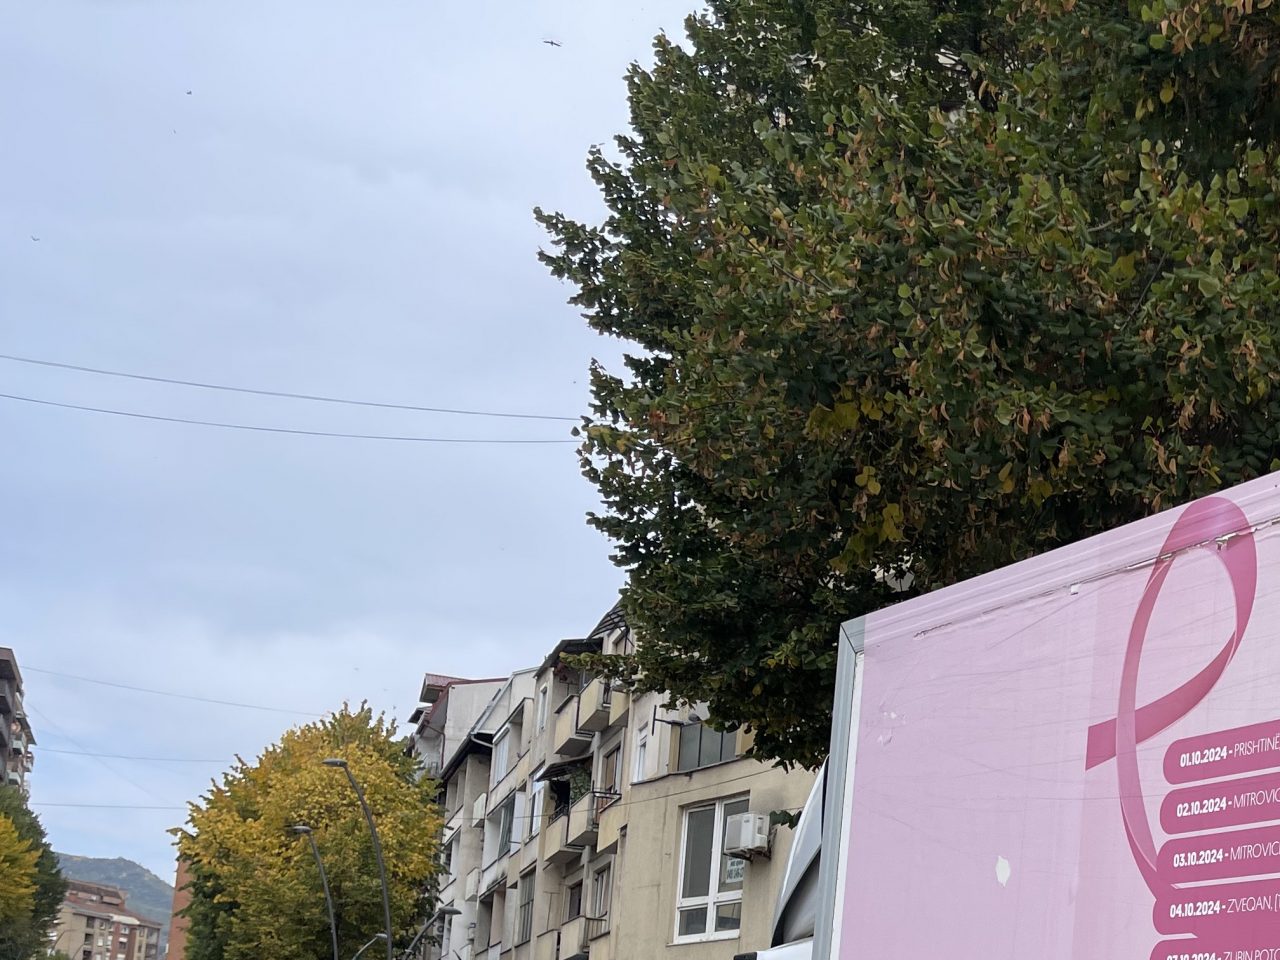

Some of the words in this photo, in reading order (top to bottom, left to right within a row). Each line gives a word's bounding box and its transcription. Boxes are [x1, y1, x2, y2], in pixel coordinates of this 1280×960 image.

[1180, 746, 1227, 767] 01.10.2024
[1177, 797, 1226, 817] 02.10.2024
[1174, 849, 1223, 867] 03.10.2024
[1170, 900, 1220, 918] 04.10.2024
[1227, 896, 1274, 914] ZVEQAN,
